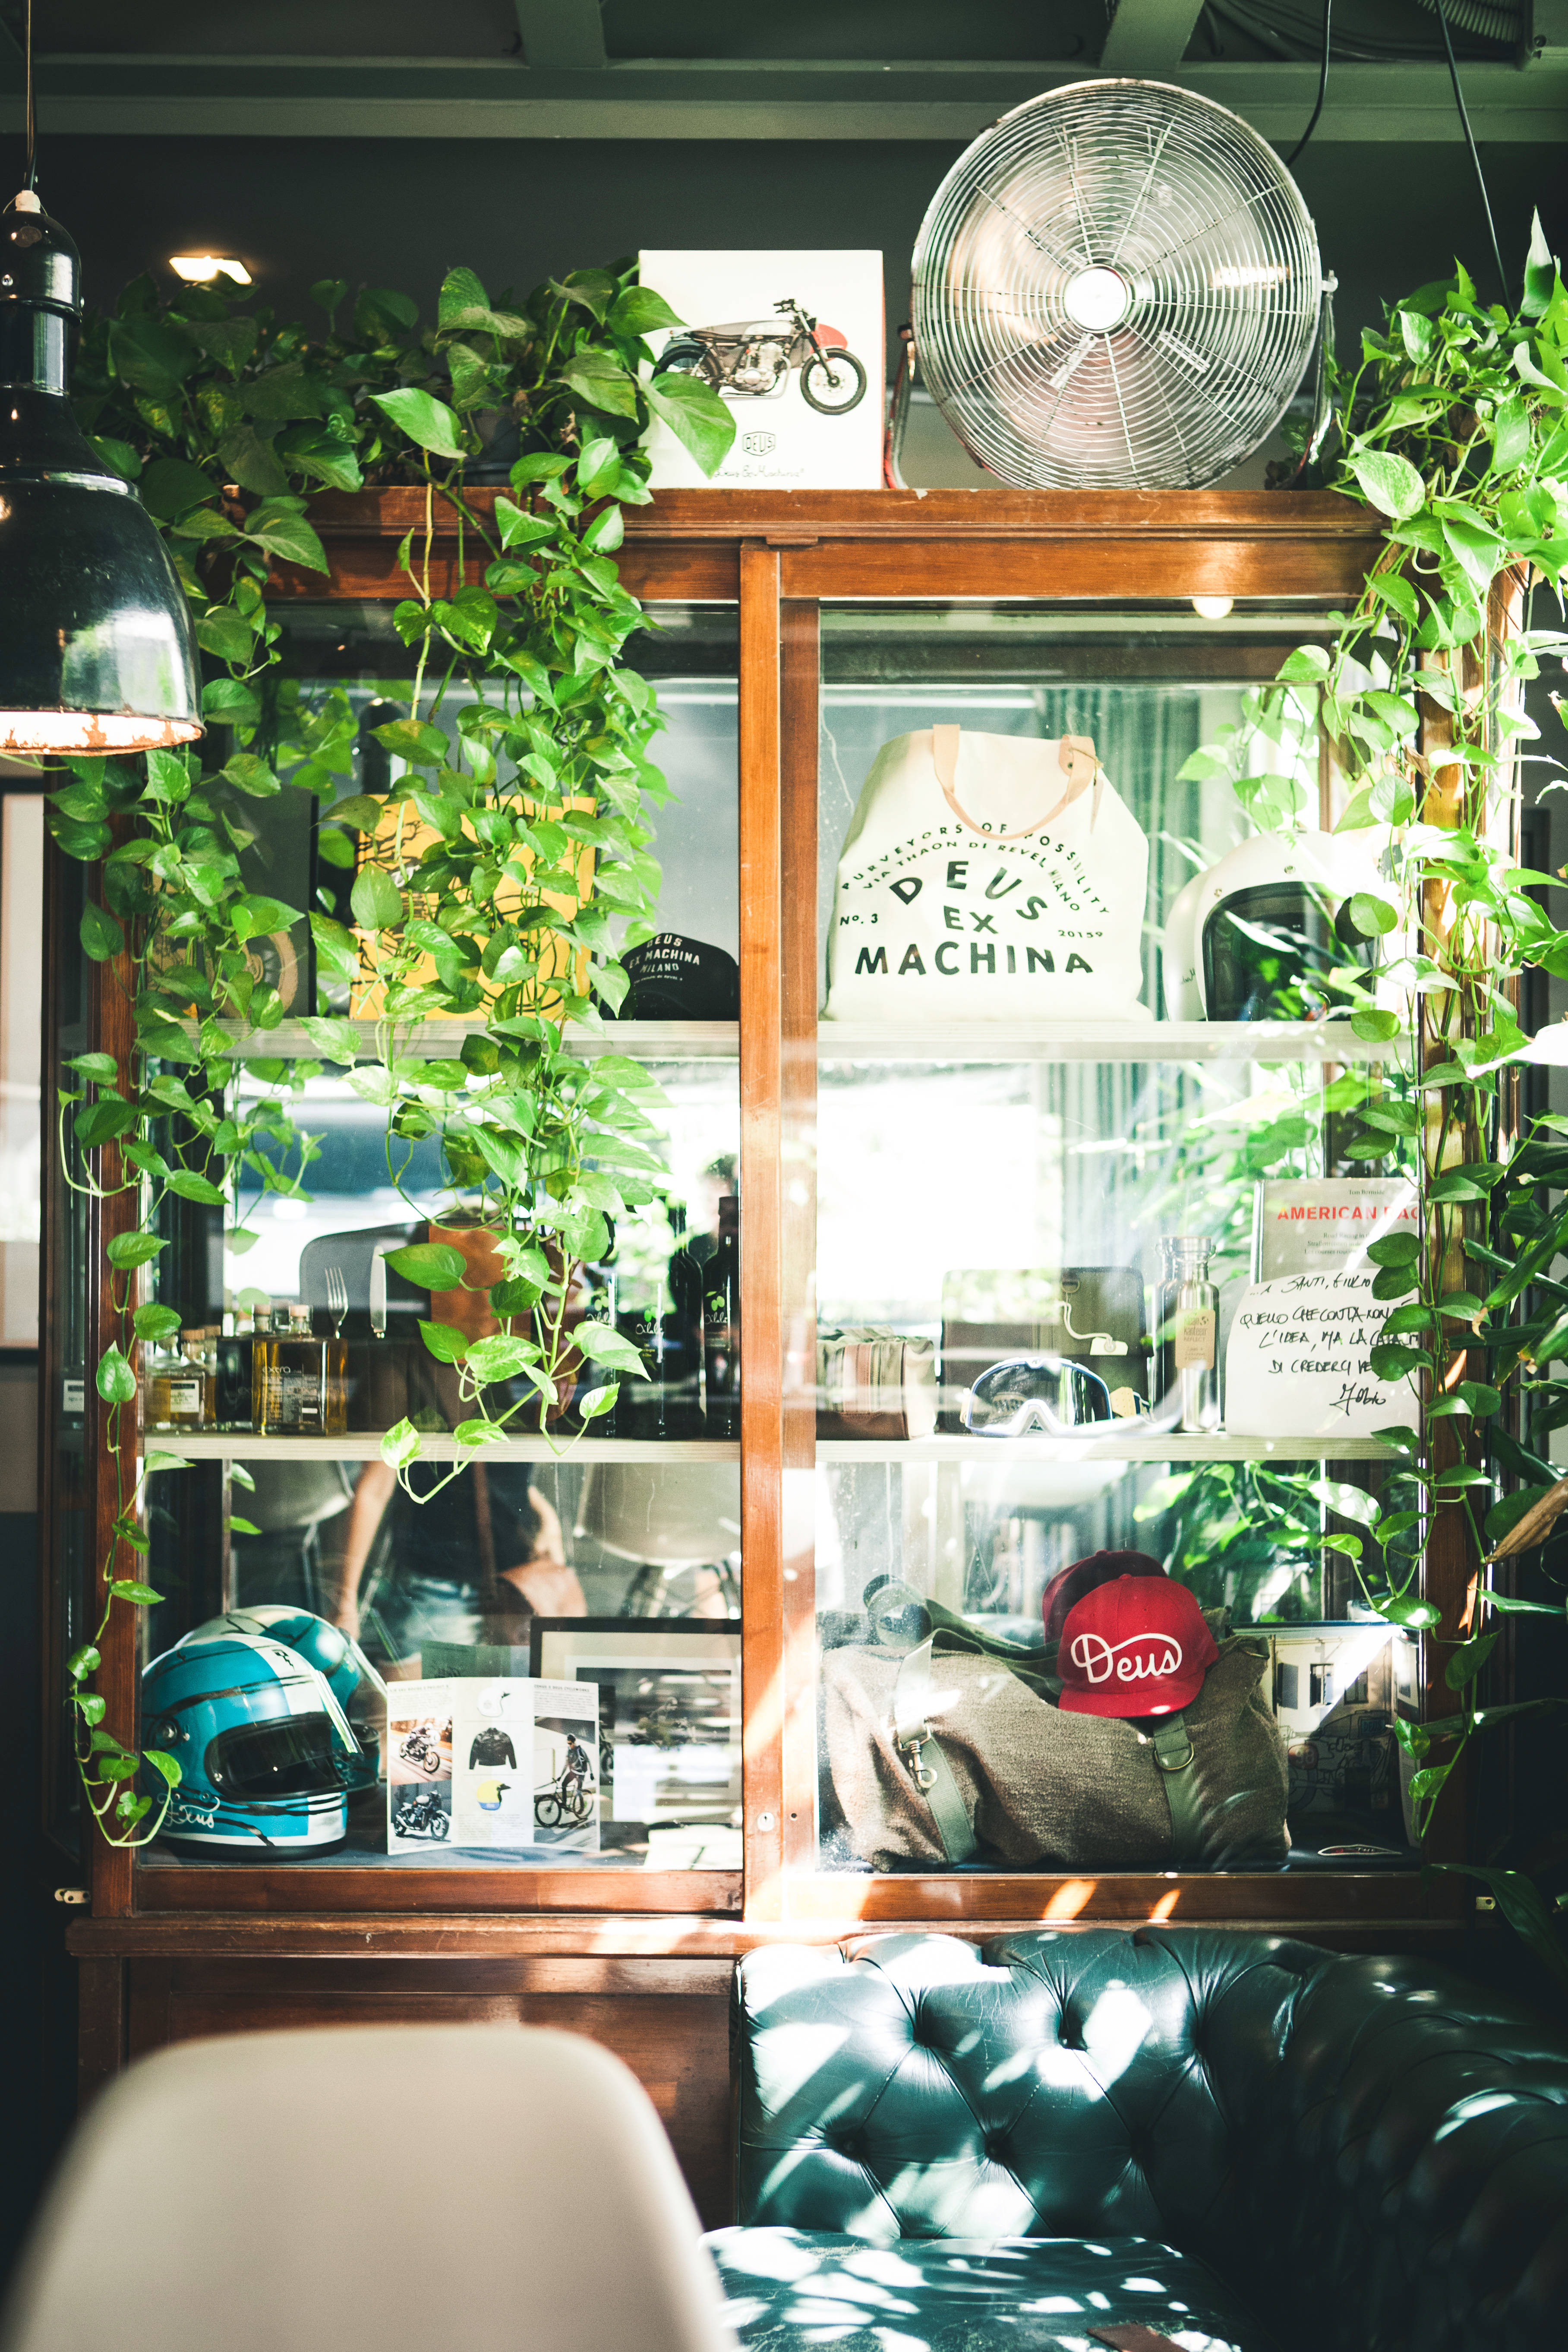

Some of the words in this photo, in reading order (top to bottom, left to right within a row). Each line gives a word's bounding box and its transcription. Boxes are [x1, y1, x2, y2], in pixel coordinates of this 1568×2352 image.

[842, 824, 963, 890] PURVEYORS
[981, 822, 1007, 834] OF
[862, 871, 890, 889] VIA
[896, 841, 957, 867] THAON
[997, 845, 1047, 868] REVEL
[889, 861, 1048, 920] DEUS
[871, 913, 878, 924] 3
[943, 905, 999, 934] EX
[1058, 929, 1103, 938] 20159
[629, 954, 641, 969] EX
[644, 948, 700, 966] MACHINA
[639, 963, 679, 973] MILANO
[855, 941, 1094, 975] MACHINA
[1277, 1206, 1377, 1220] AMERICAN
[1070, 1633, 1183, 1683] Deus
